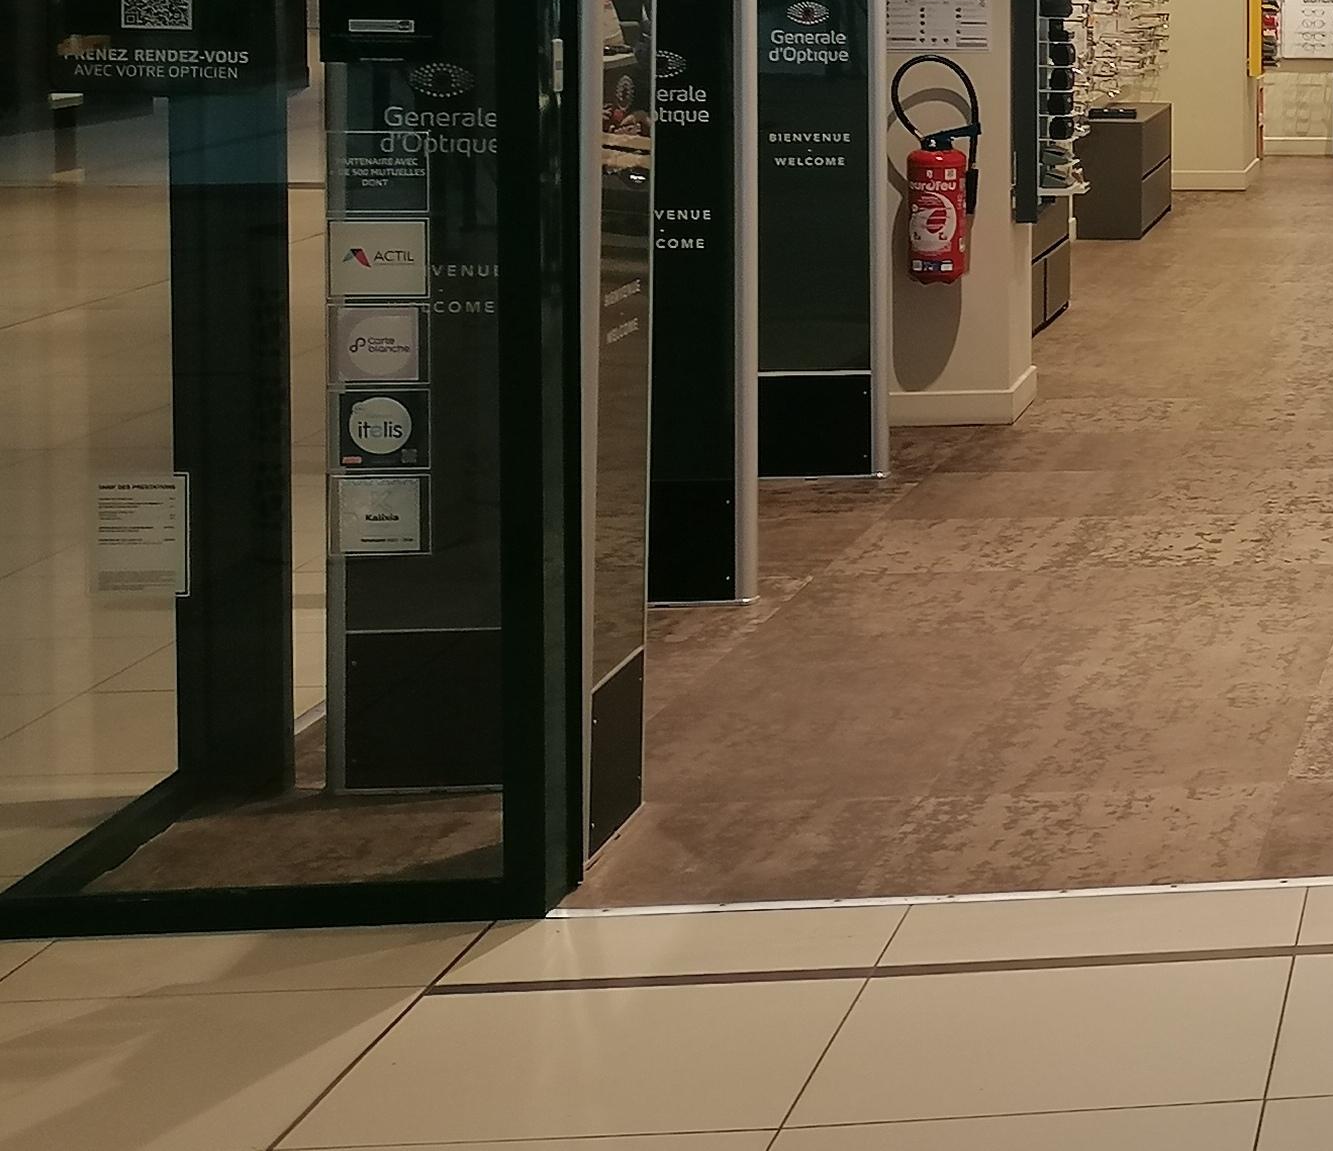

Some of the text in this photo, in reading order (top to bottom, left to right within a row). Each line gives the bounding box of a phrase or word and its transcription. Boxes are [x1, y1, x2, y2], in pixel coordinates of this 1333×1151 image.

[770, 29, 847, 45] Generale
[134, 50, 249, 64] RENDEZ-VOUS
[768, 47, 849, 64] d'Optique
[74, 65, 238, 79] AVEC VOTRE OPTICIEN
[384, 106, 498, 127] Generale
[769, 132, 851, 143] BIENVENUE
[380, 132, 498, 158] d'Optique
[394, 158, 419, 166] AVEC
[774, 156, 846, 166] WELCOME
[373, 250, 415, 262] ACTIL
[358, 421, 403, 439] itelis
